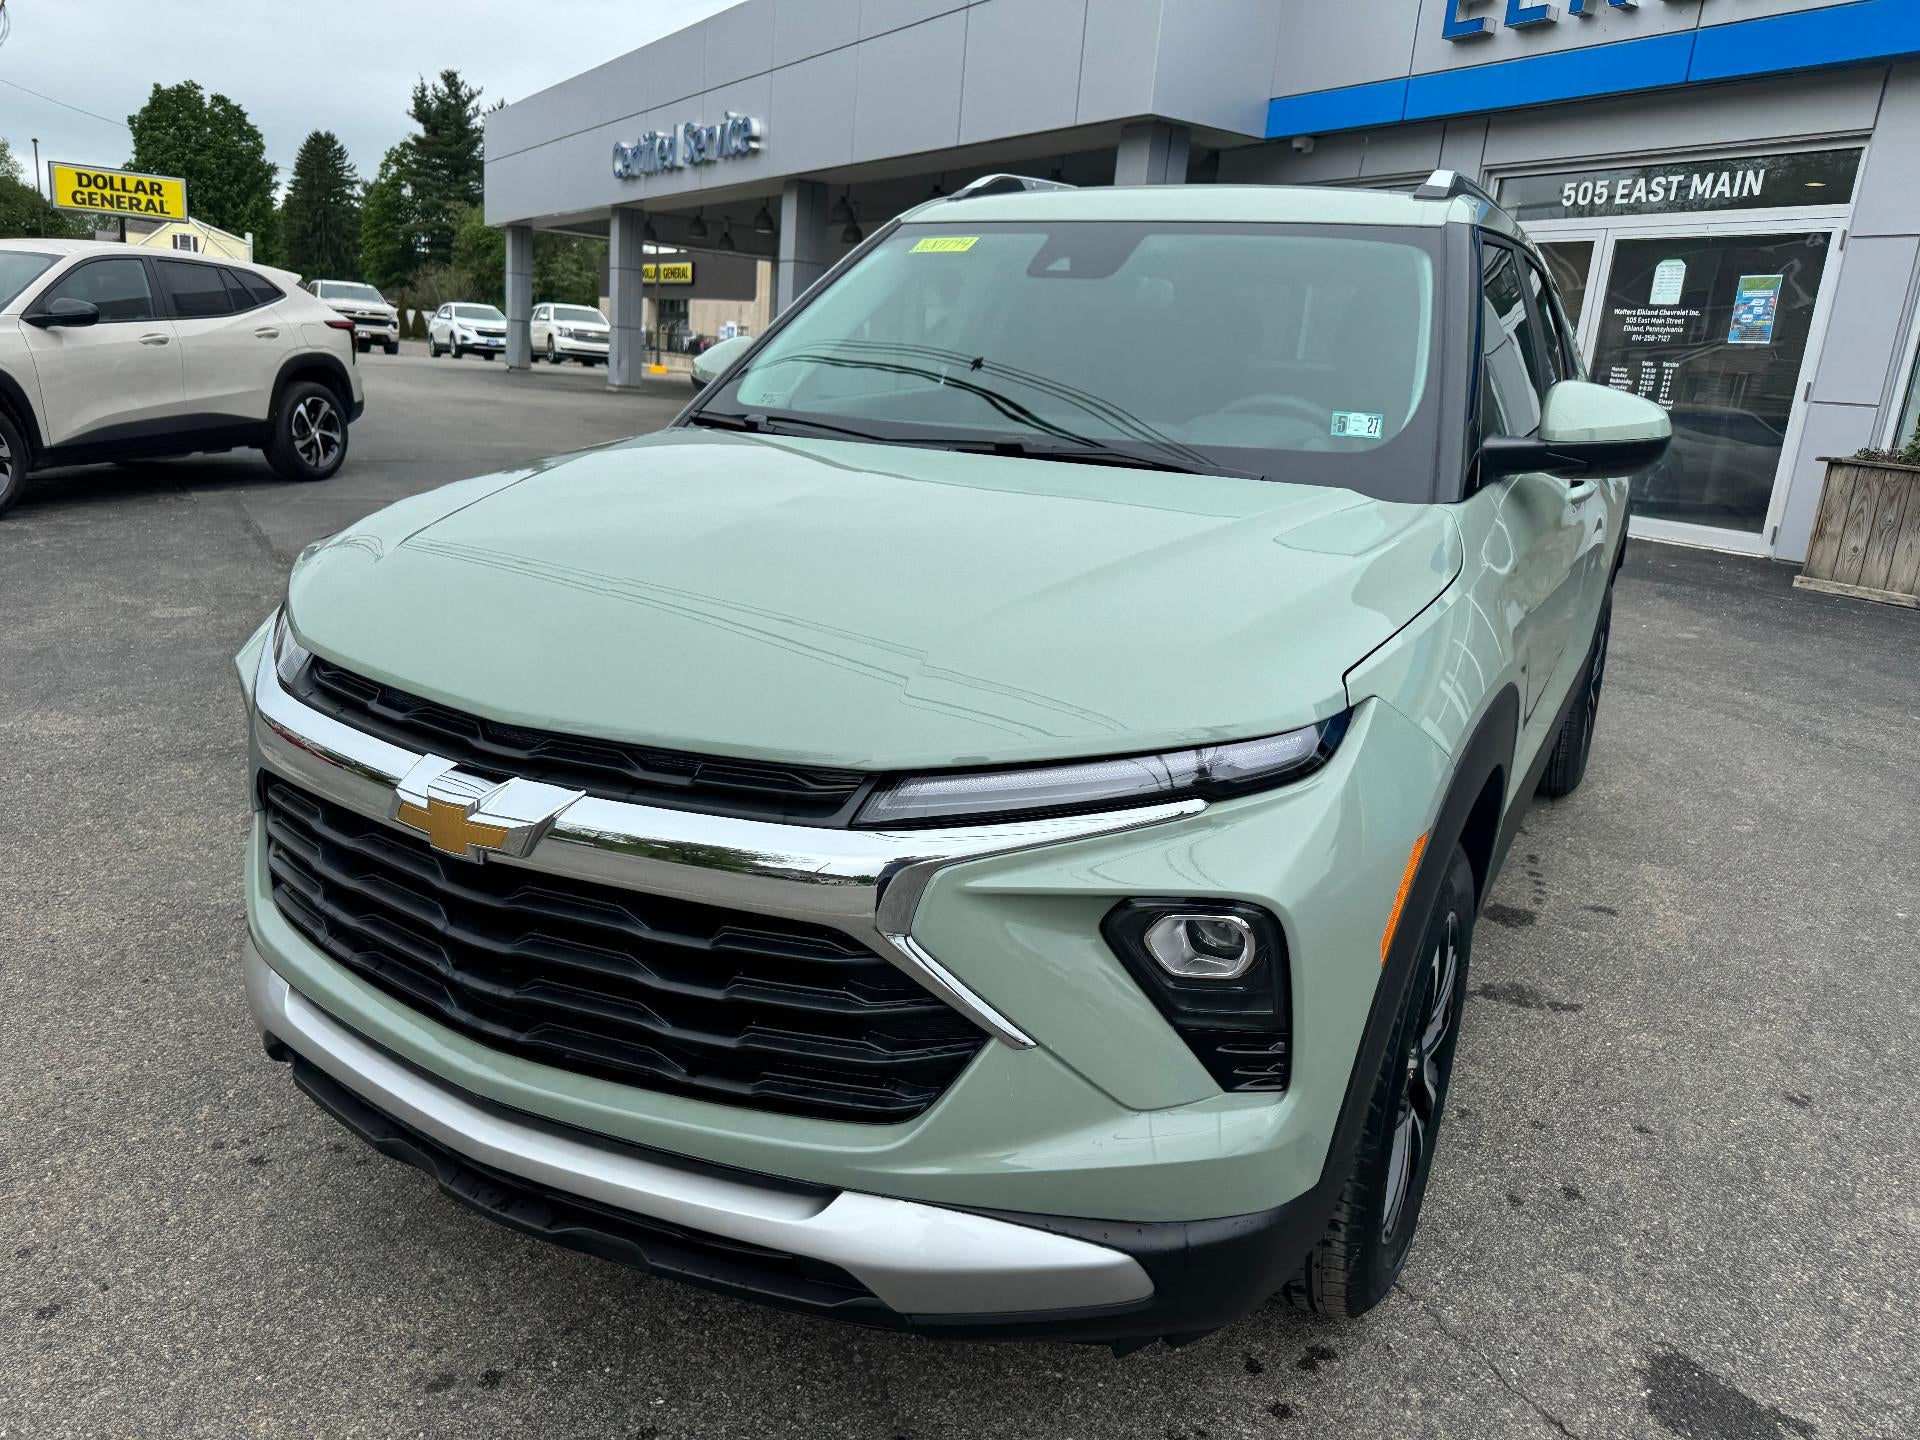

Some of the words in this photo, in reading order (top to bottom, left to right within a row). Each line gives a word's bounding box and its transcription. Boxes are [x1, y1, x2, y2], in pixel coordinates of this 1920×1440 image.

[613, 124, 683, 178] Certified
[683, 110, 760, 165] Service
[75, 172, 164, 197] DOLLAR
[1561, 181, 1609, 207] 505
[1613, 174, 1684, 205] EAST
[1687, 169, 1766, 199] MAIN
[71, 190, 170, 214] GENERAL
[663, 266, 689, 279] GENERAL
[1636, 308, 1658, 316] Elkland
[1659, 308, 1688, 316] Chevrolet
[1646, 326, 1684, 334] Pennsylvania
[1367, 417, 1379, 434] 27
